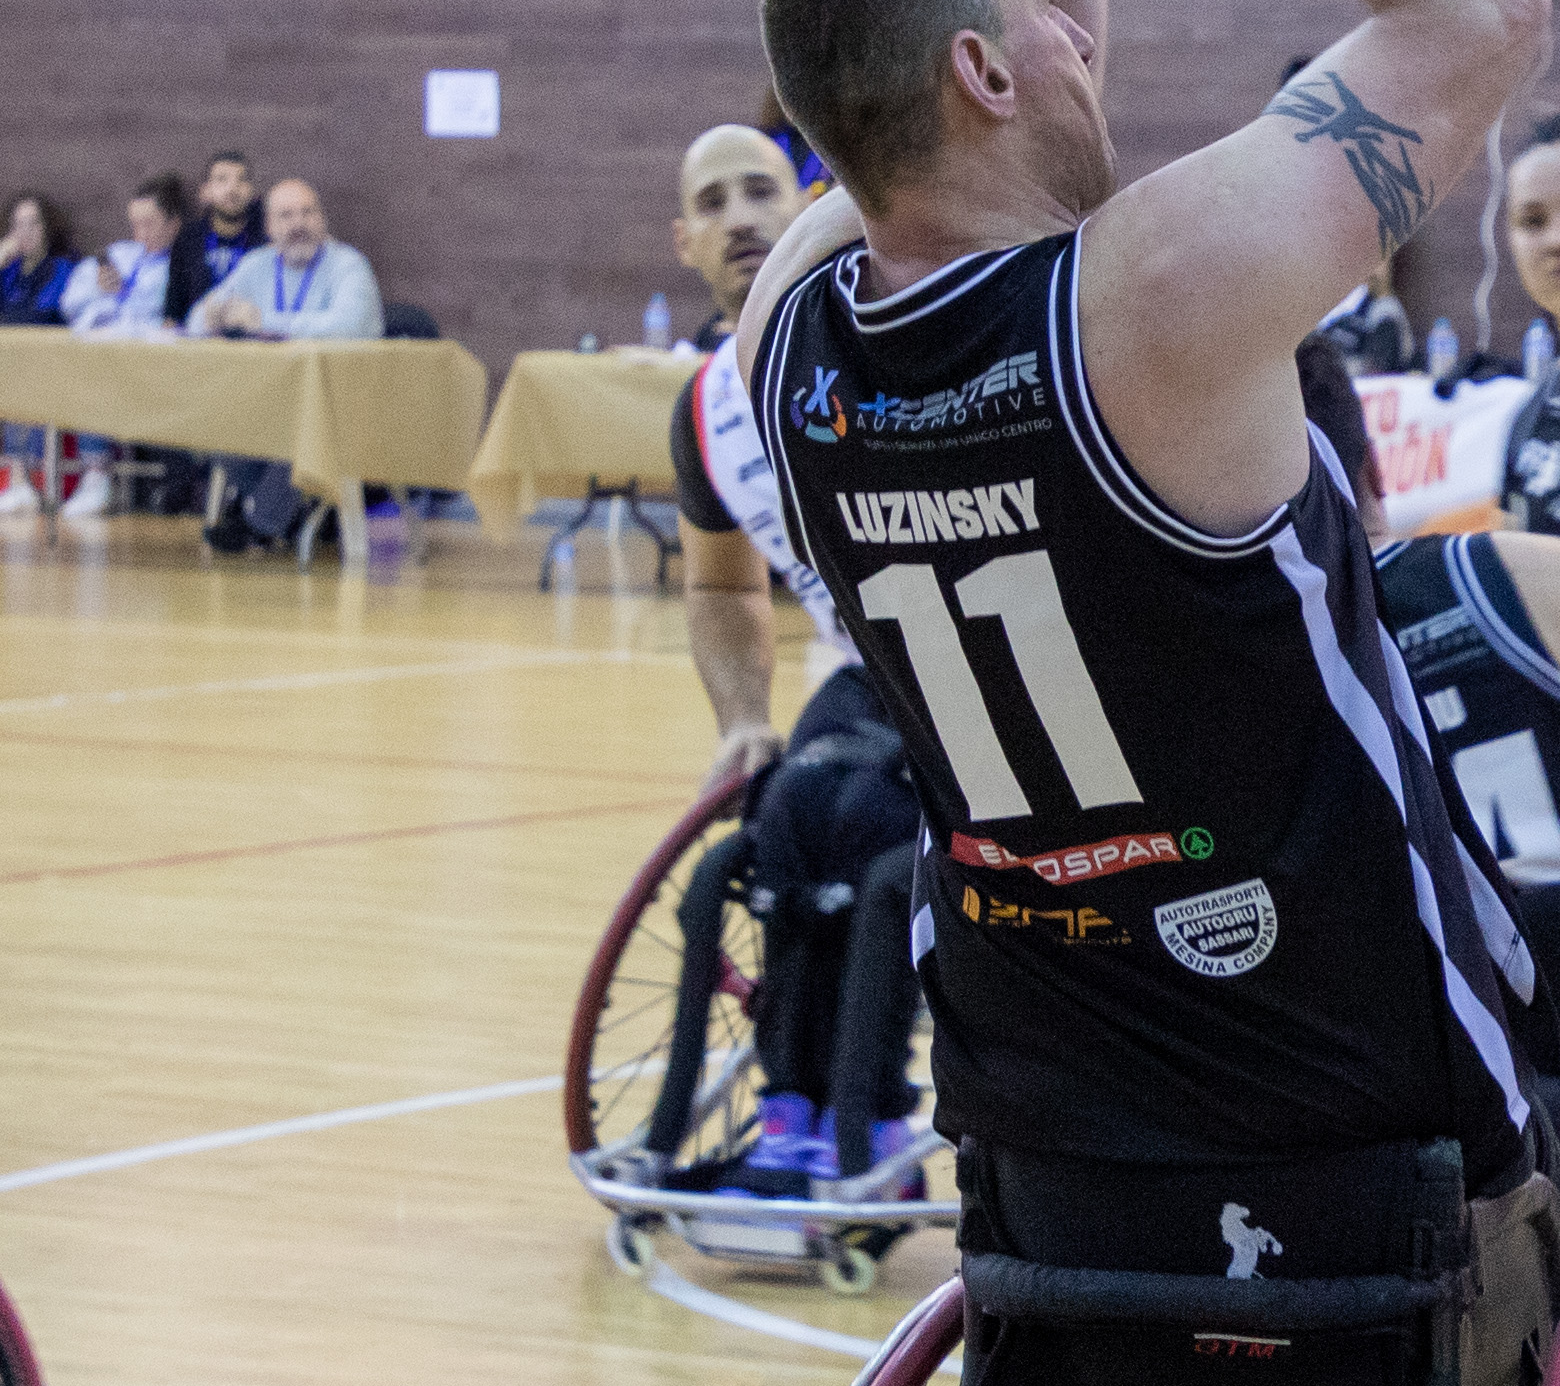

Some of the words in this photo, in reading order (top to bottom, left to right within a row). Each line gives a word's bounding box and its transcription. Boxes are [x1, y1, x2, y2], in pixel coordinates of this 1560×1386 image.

[1001, 417, 1053, 440] CENTRO
[836, 478, 1040, 543] LUZINSKY
[857, 550, 1145, 821] 11
[978, 836, 1178, 883] EOSPAR
[1159, 883, 1266, 925] AUTOTRASPORTI
[1182, 905, 1257, 940] AUTOGRU
[1165, 931, 1228, 976] MESINA
[1232, 903, 1276, 970] COMPANY
